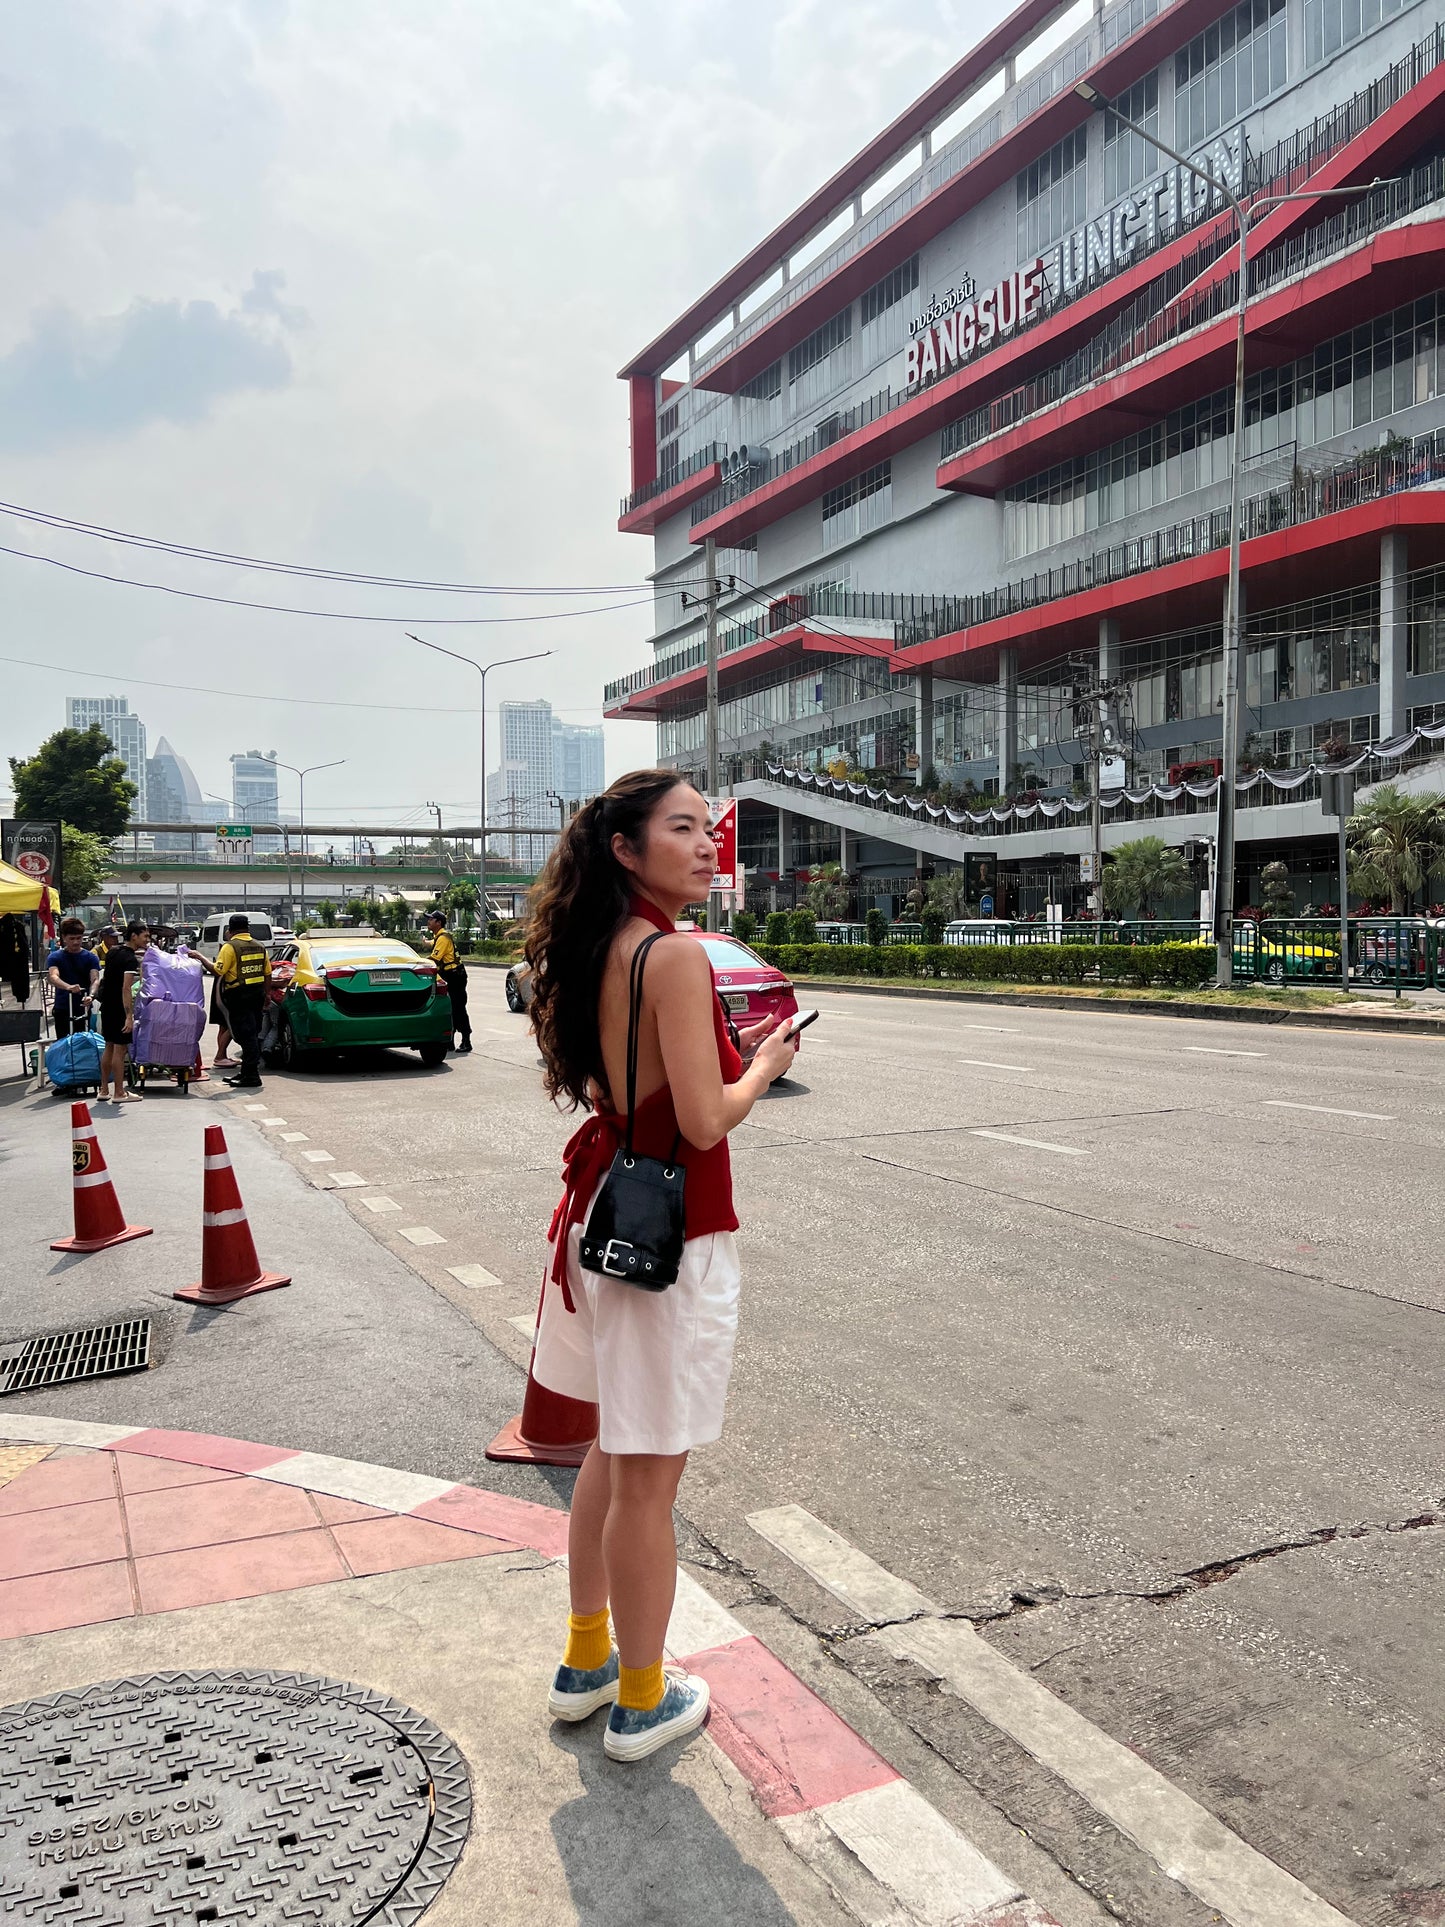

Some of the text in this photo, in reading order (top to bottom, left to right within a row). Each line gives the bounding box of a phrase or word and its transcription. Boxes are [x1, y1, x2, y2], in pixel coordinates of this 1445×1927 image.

[904, 124, 1246, 387] BANGSUE JUNCTION
[28, 1794, 215, 1847] No.19/2566
